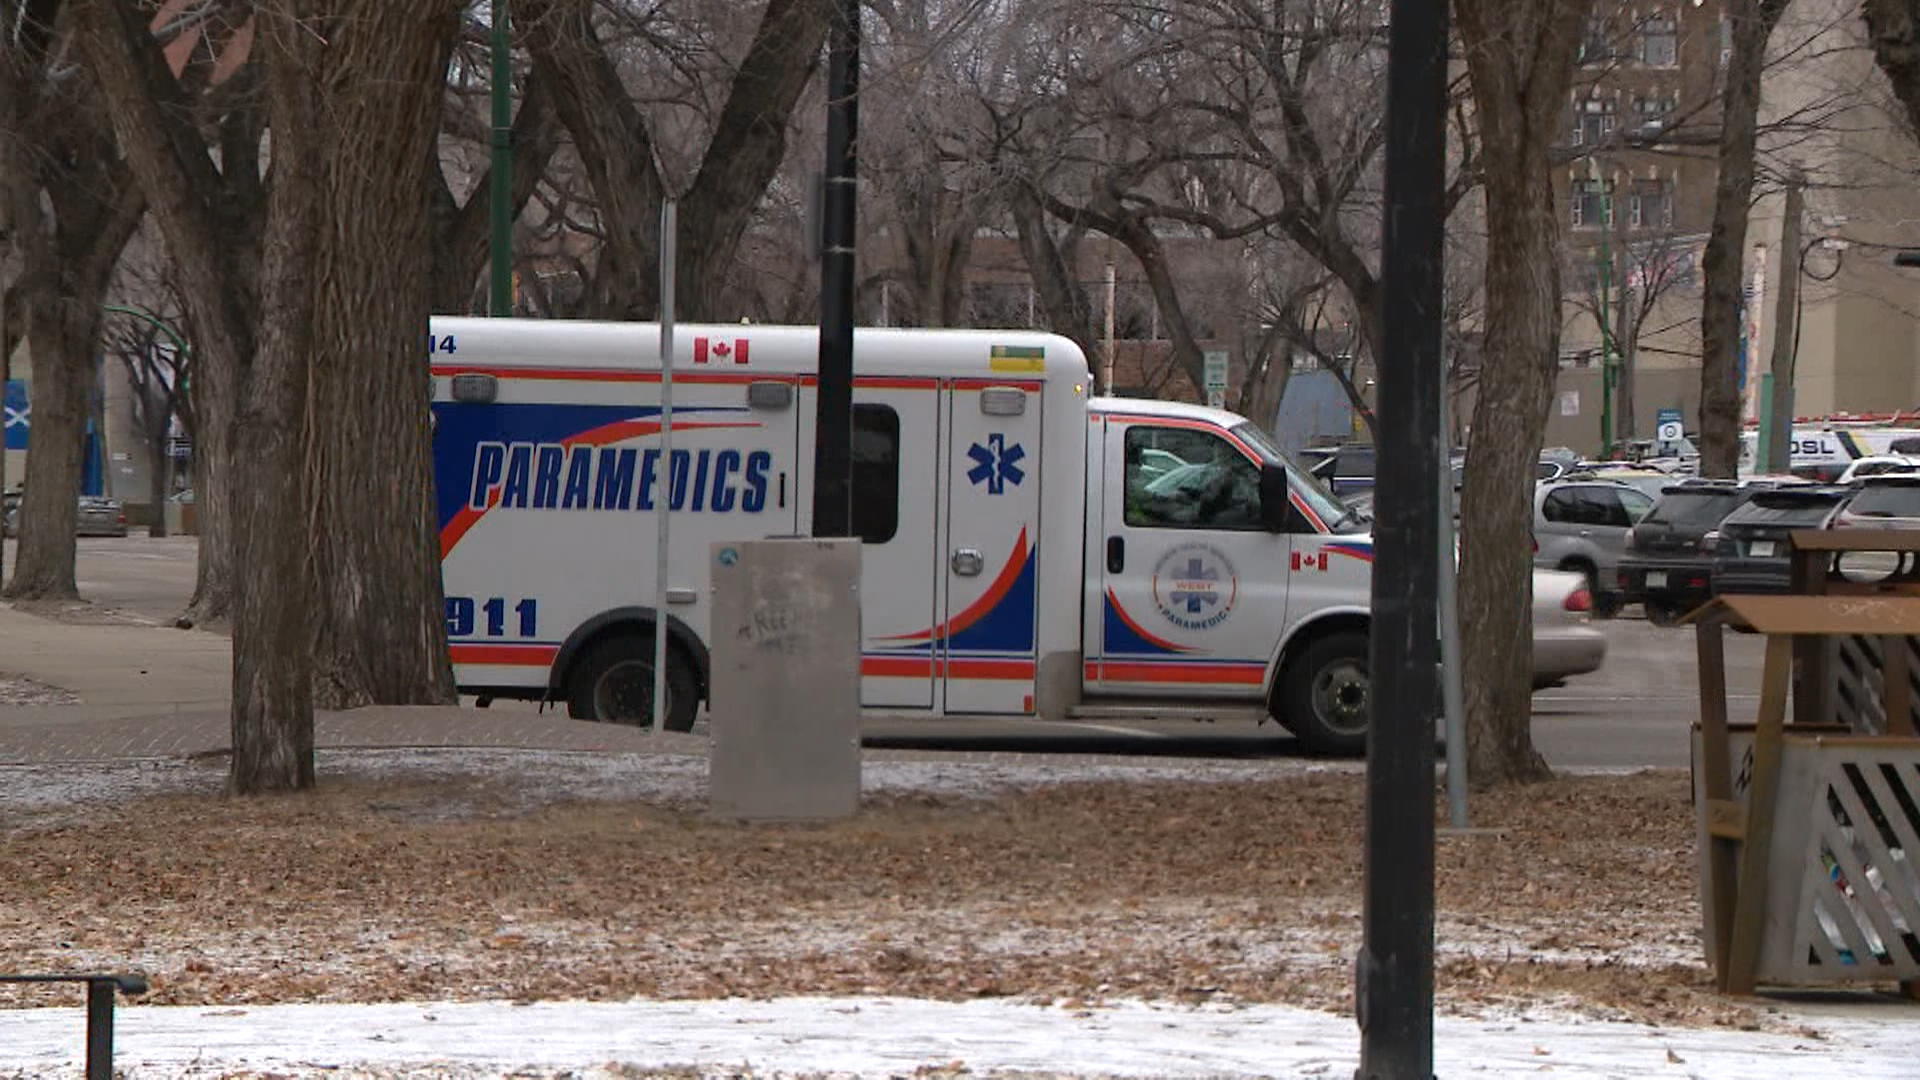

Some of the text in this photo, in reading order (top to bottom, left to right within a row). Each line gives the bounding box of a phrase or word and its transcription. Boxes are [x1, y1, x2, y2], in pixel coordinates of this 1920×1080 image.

[470, 442, 771, 513] PARAMEDICS
[444, 597, 537, 637] 911
[1160, 607, 1228, 630] PARAMEDIC
